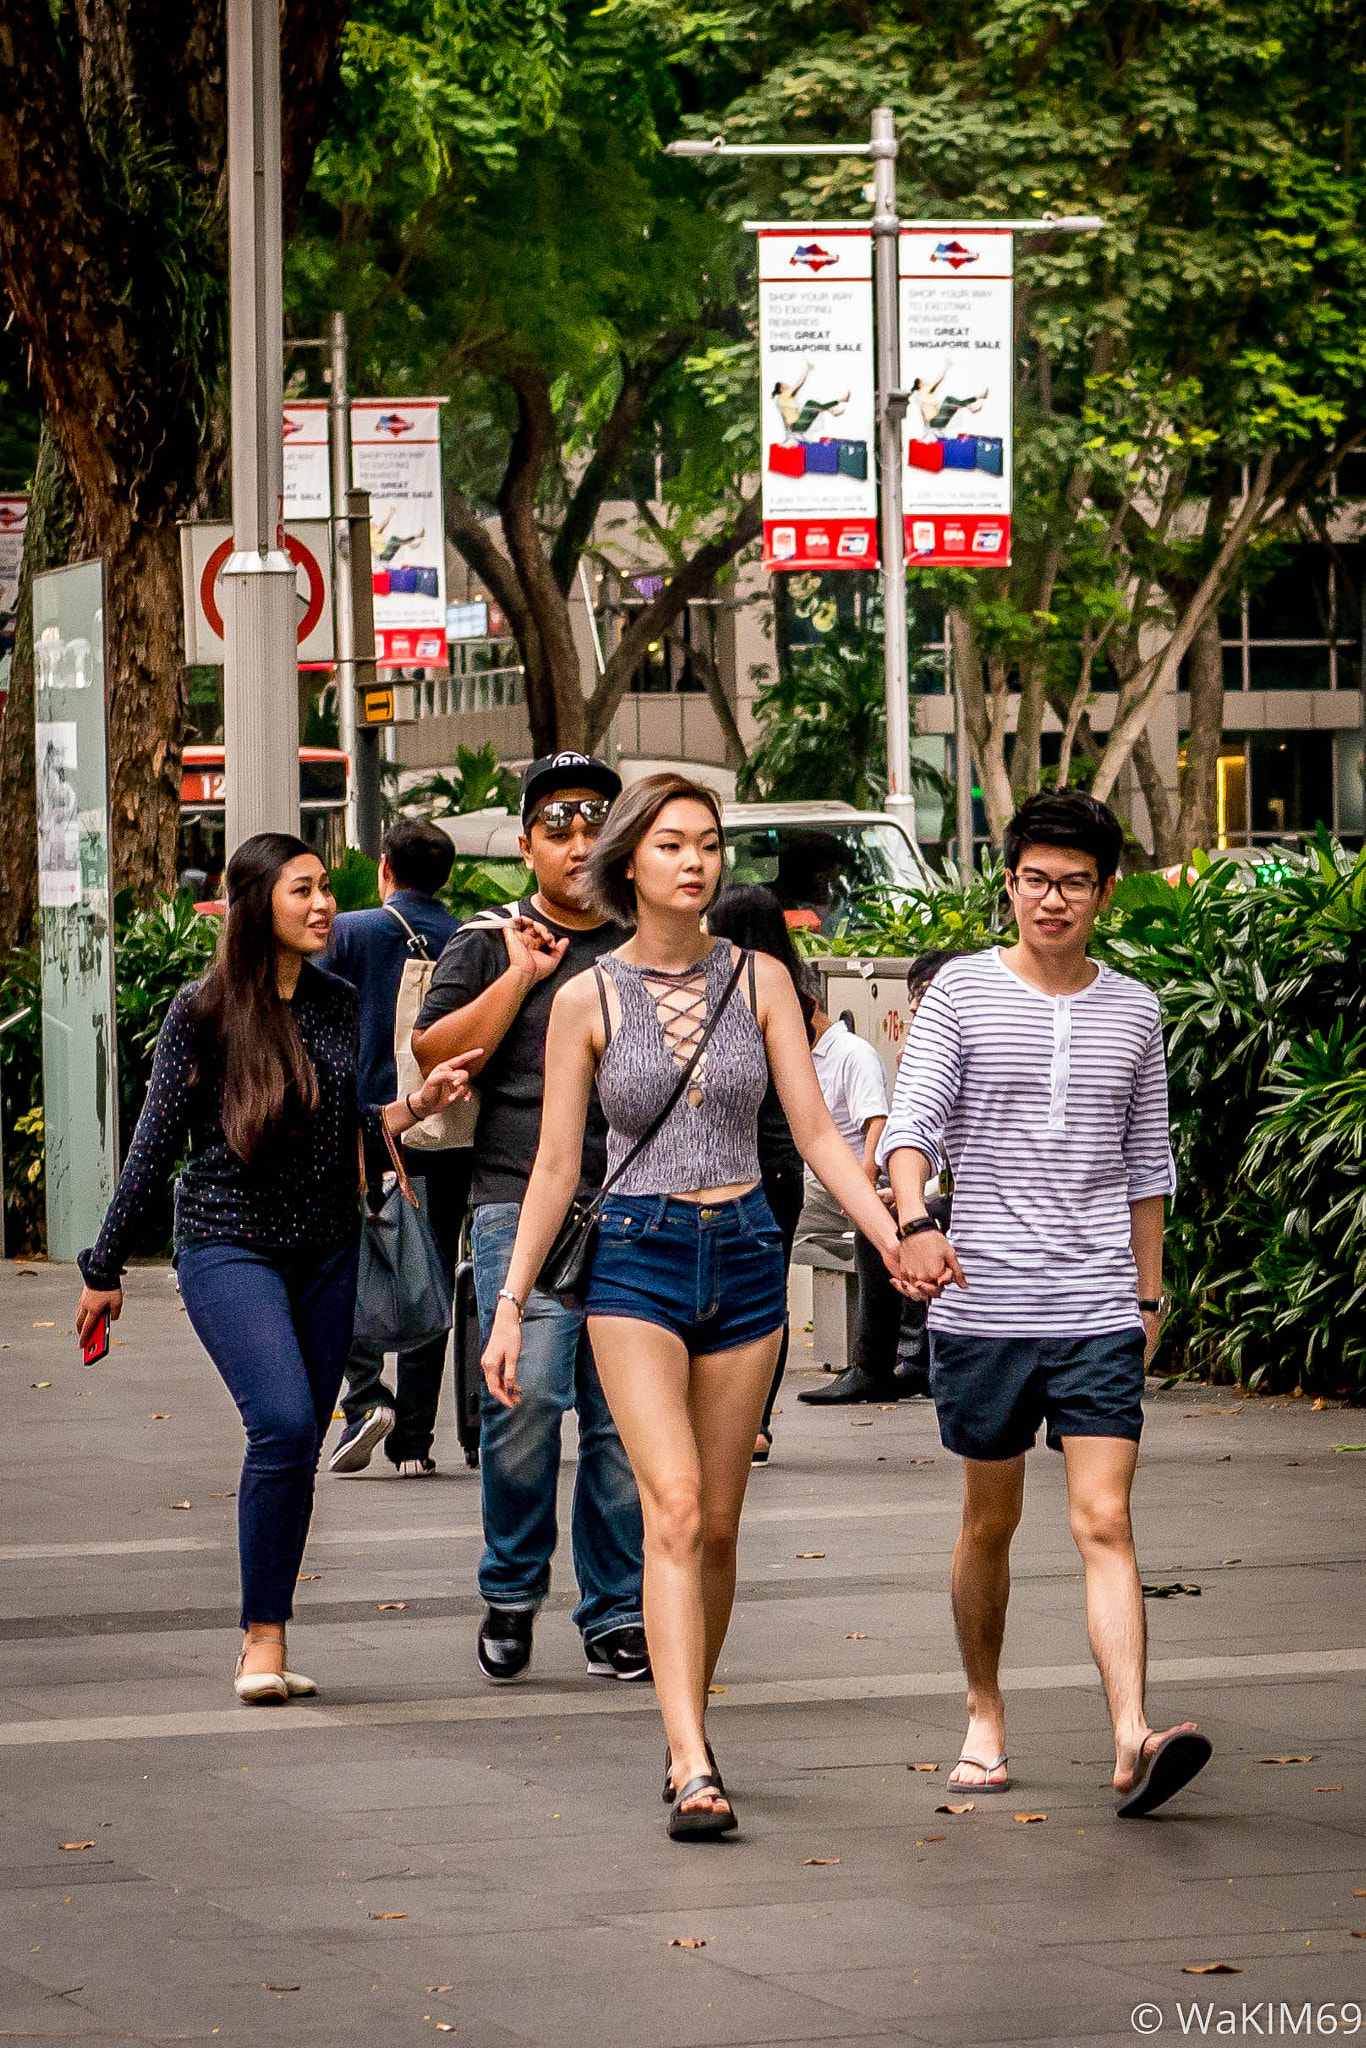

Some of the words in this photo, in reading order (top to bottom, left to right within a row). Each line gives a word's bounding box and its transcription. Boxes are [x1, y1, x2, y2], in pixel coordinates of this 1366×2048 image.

[794, 331, 831, 340] GREAT
[934, 327, 970, 336] GREAT
[769, 344, 831, 352] SINGAPORE
[835, 343, 862, 352] SALE
[908, 340, 969, 349] SINGAPORE
[974, 340, 1001, 349] SALE
